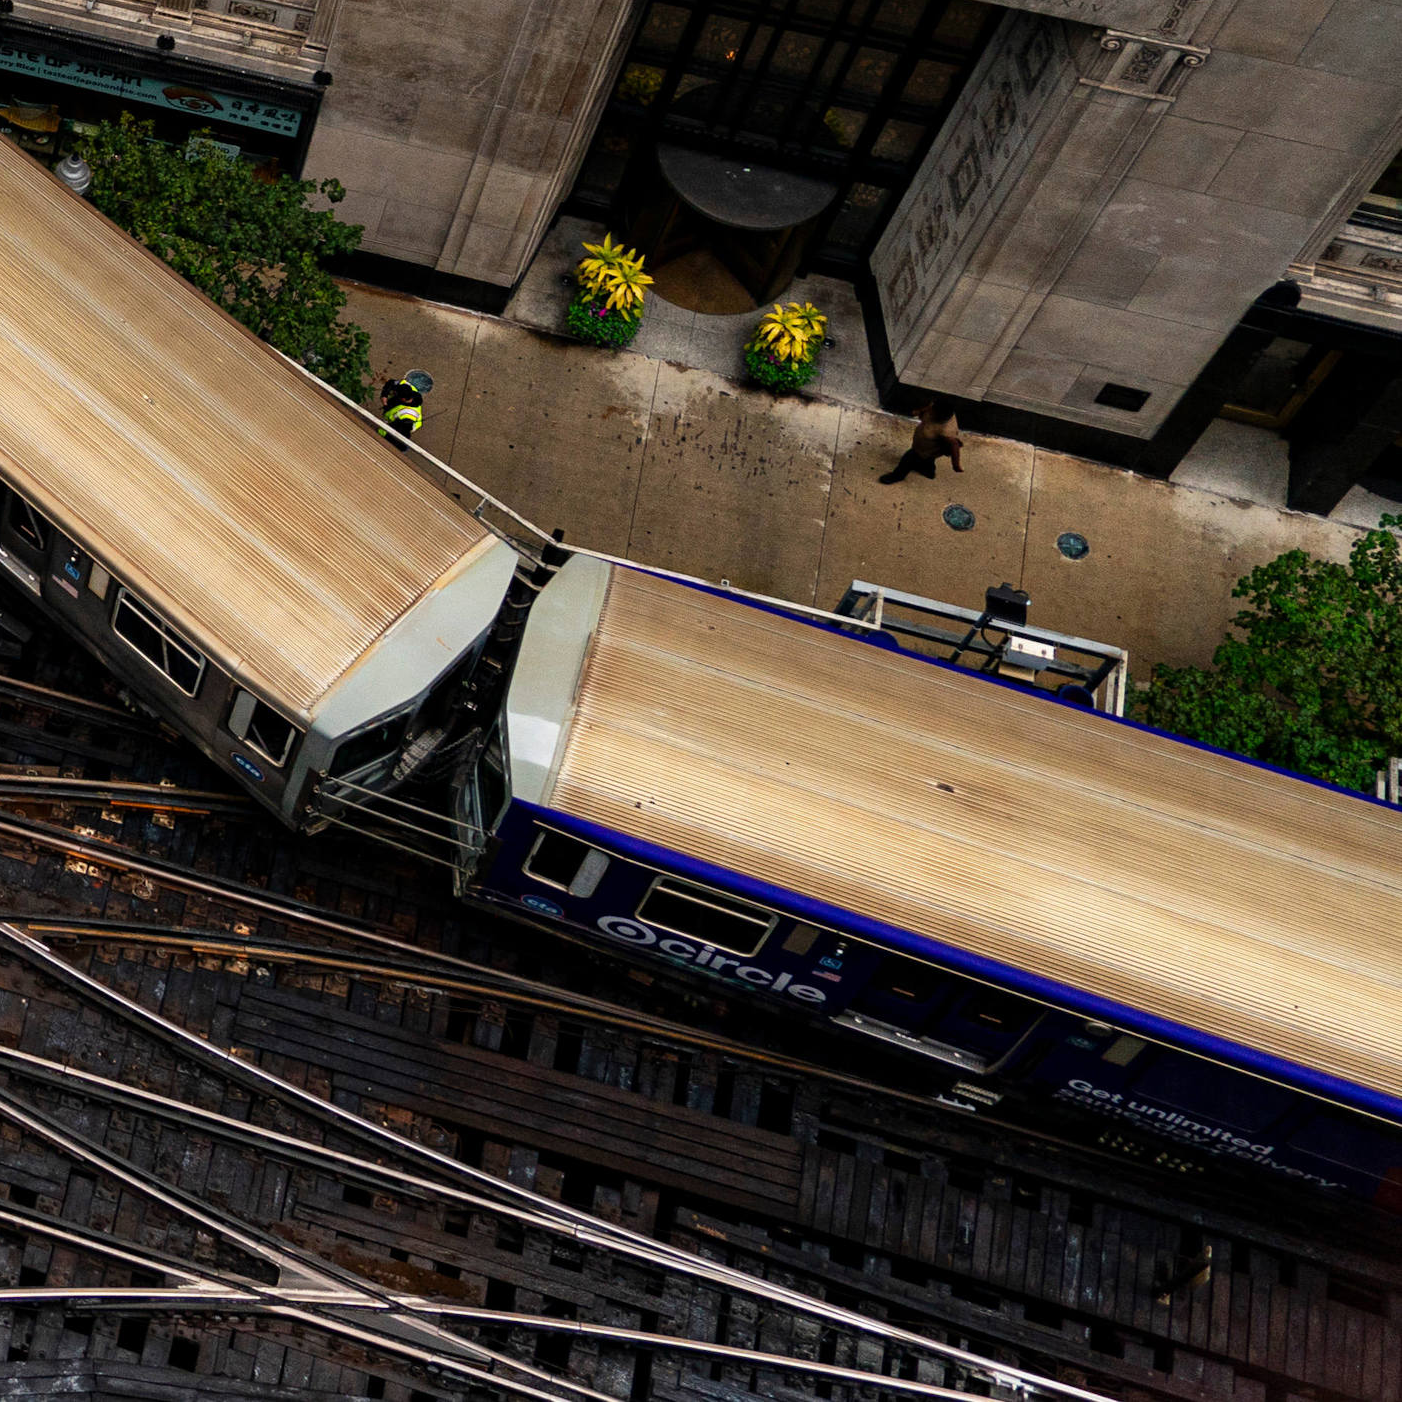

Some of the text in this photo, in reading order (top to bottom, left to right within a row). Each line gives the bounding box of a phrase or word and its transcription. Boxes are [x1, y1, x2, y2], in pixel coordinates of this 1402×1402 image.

[16, 62, 36, 72] Rice
[44, 56, 70, 68] OF
[527, 898, 559, 914] cta
[659, 938, 827, 1004] circle
[1067, 1079, 1274, 1155] Get unlimited
